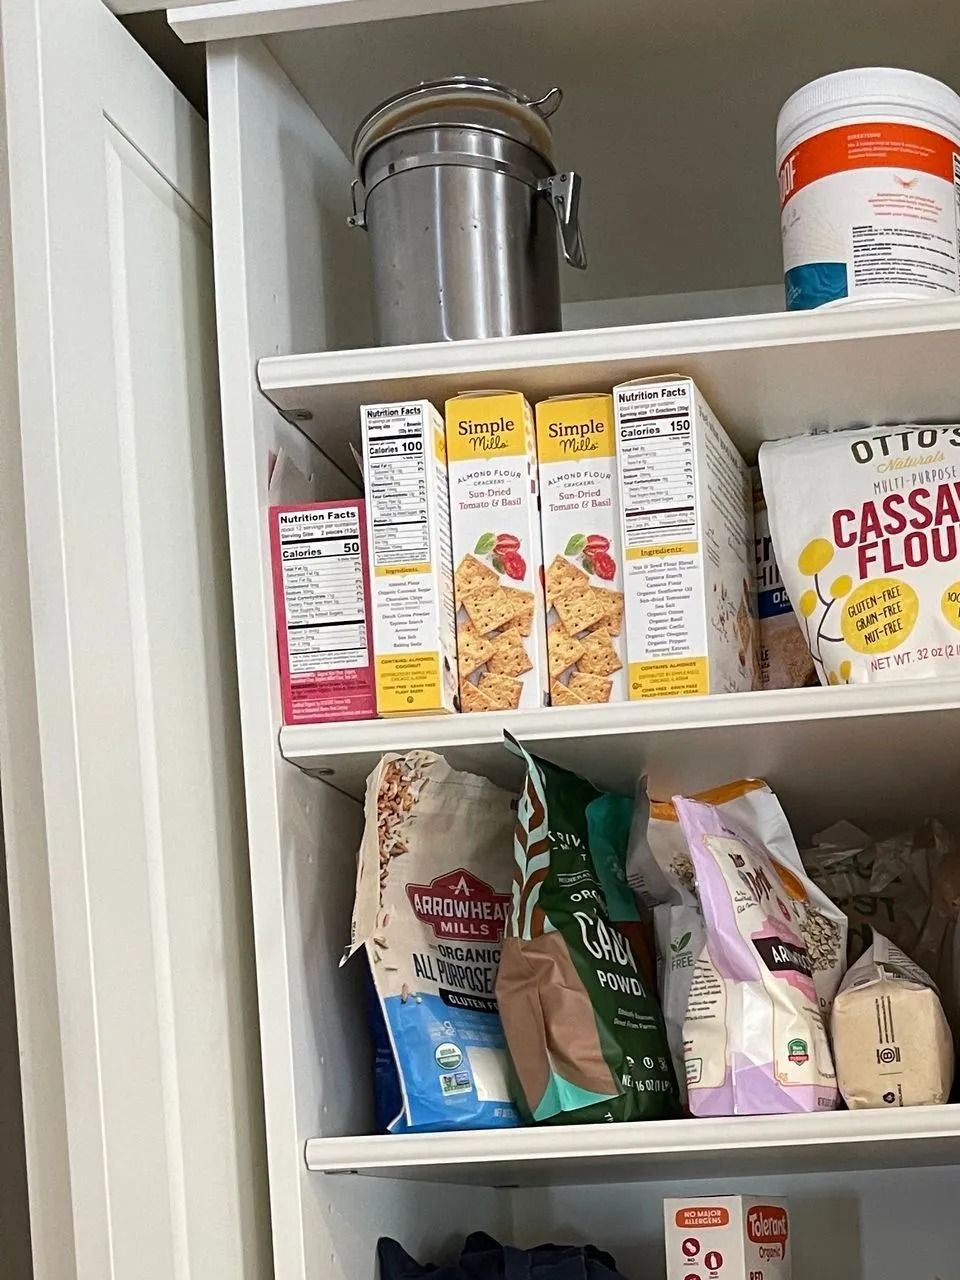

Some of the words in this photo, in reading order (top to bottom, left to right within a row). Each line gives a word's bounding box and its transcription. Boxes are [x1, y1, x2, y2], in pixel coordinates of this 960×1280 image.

[618, 392, 659, 404] Nutrition
[661, 387, 687, 397] Facts
[367, 408, 399, 418] Nutrition
[401, 406, 421, 415] Facts
[458, 417, 515, 436] Simple
[548, 420, 605, 439] Simple
[620, 427, 661, 438] Calories
[670, 420, 690, 432] 150
[369, 445, 399, 455] Calories
[402, 441, 422, 451] 100
[469, 436, 508, 452] Mills
[560, 437, 598, 453] Mills
[876, 451, 945, 474] Naturals
[457, 470, 492, 485] ALMOND
[494, 469, 522, 479] FLOUR
[548, 472, 582, 486] ALMOND
[584, 471, 612, 480] FLOUR
[873, 465, 958, 495] MULTI-PURPOSE
[468, 488, 511, 499] Sun-Dried
[558, 489, 601, 501] Sun-Dried
[459, 501, 489, 511] Tomato
[501, 498, 522, 507] Basil
[549, 503, 579, 512] Tomato
[591, 500, 612, 508] Basil
[280, 513, 325, 524] Nutrition
[327, 511, 356, 520] Facts
[282, 547, 322, 558] Calories
[344, 542, 360, 553] 50
[847, 584, 903, 618] GLUTEN-FREE
[855, 602, 903, 631] GRAIN-FREE
[864, 620, 904, 646] NUT-FREE
[870, 658, 891, 672] NET
[917, 648, 930, 661] 32
[931, 647, 943, 658] oz
[945, 644, 954, 659] (2
[440, 921, 490, 935] MILLS
[412, 953, 438, 982] ALL
[436, 959, 493, 993] PURPOSE
[448, 994, 487, 1009] GLUTEN
[684, 1210, 696, 1218] NO
[697, 1209, 721, 1217] MAJOR
[684, 1217, 722, 1225] ALLERGENS
[749, 1212, 787, 1238] Tolerant
[759, 1246, 781, 1262] Organic
